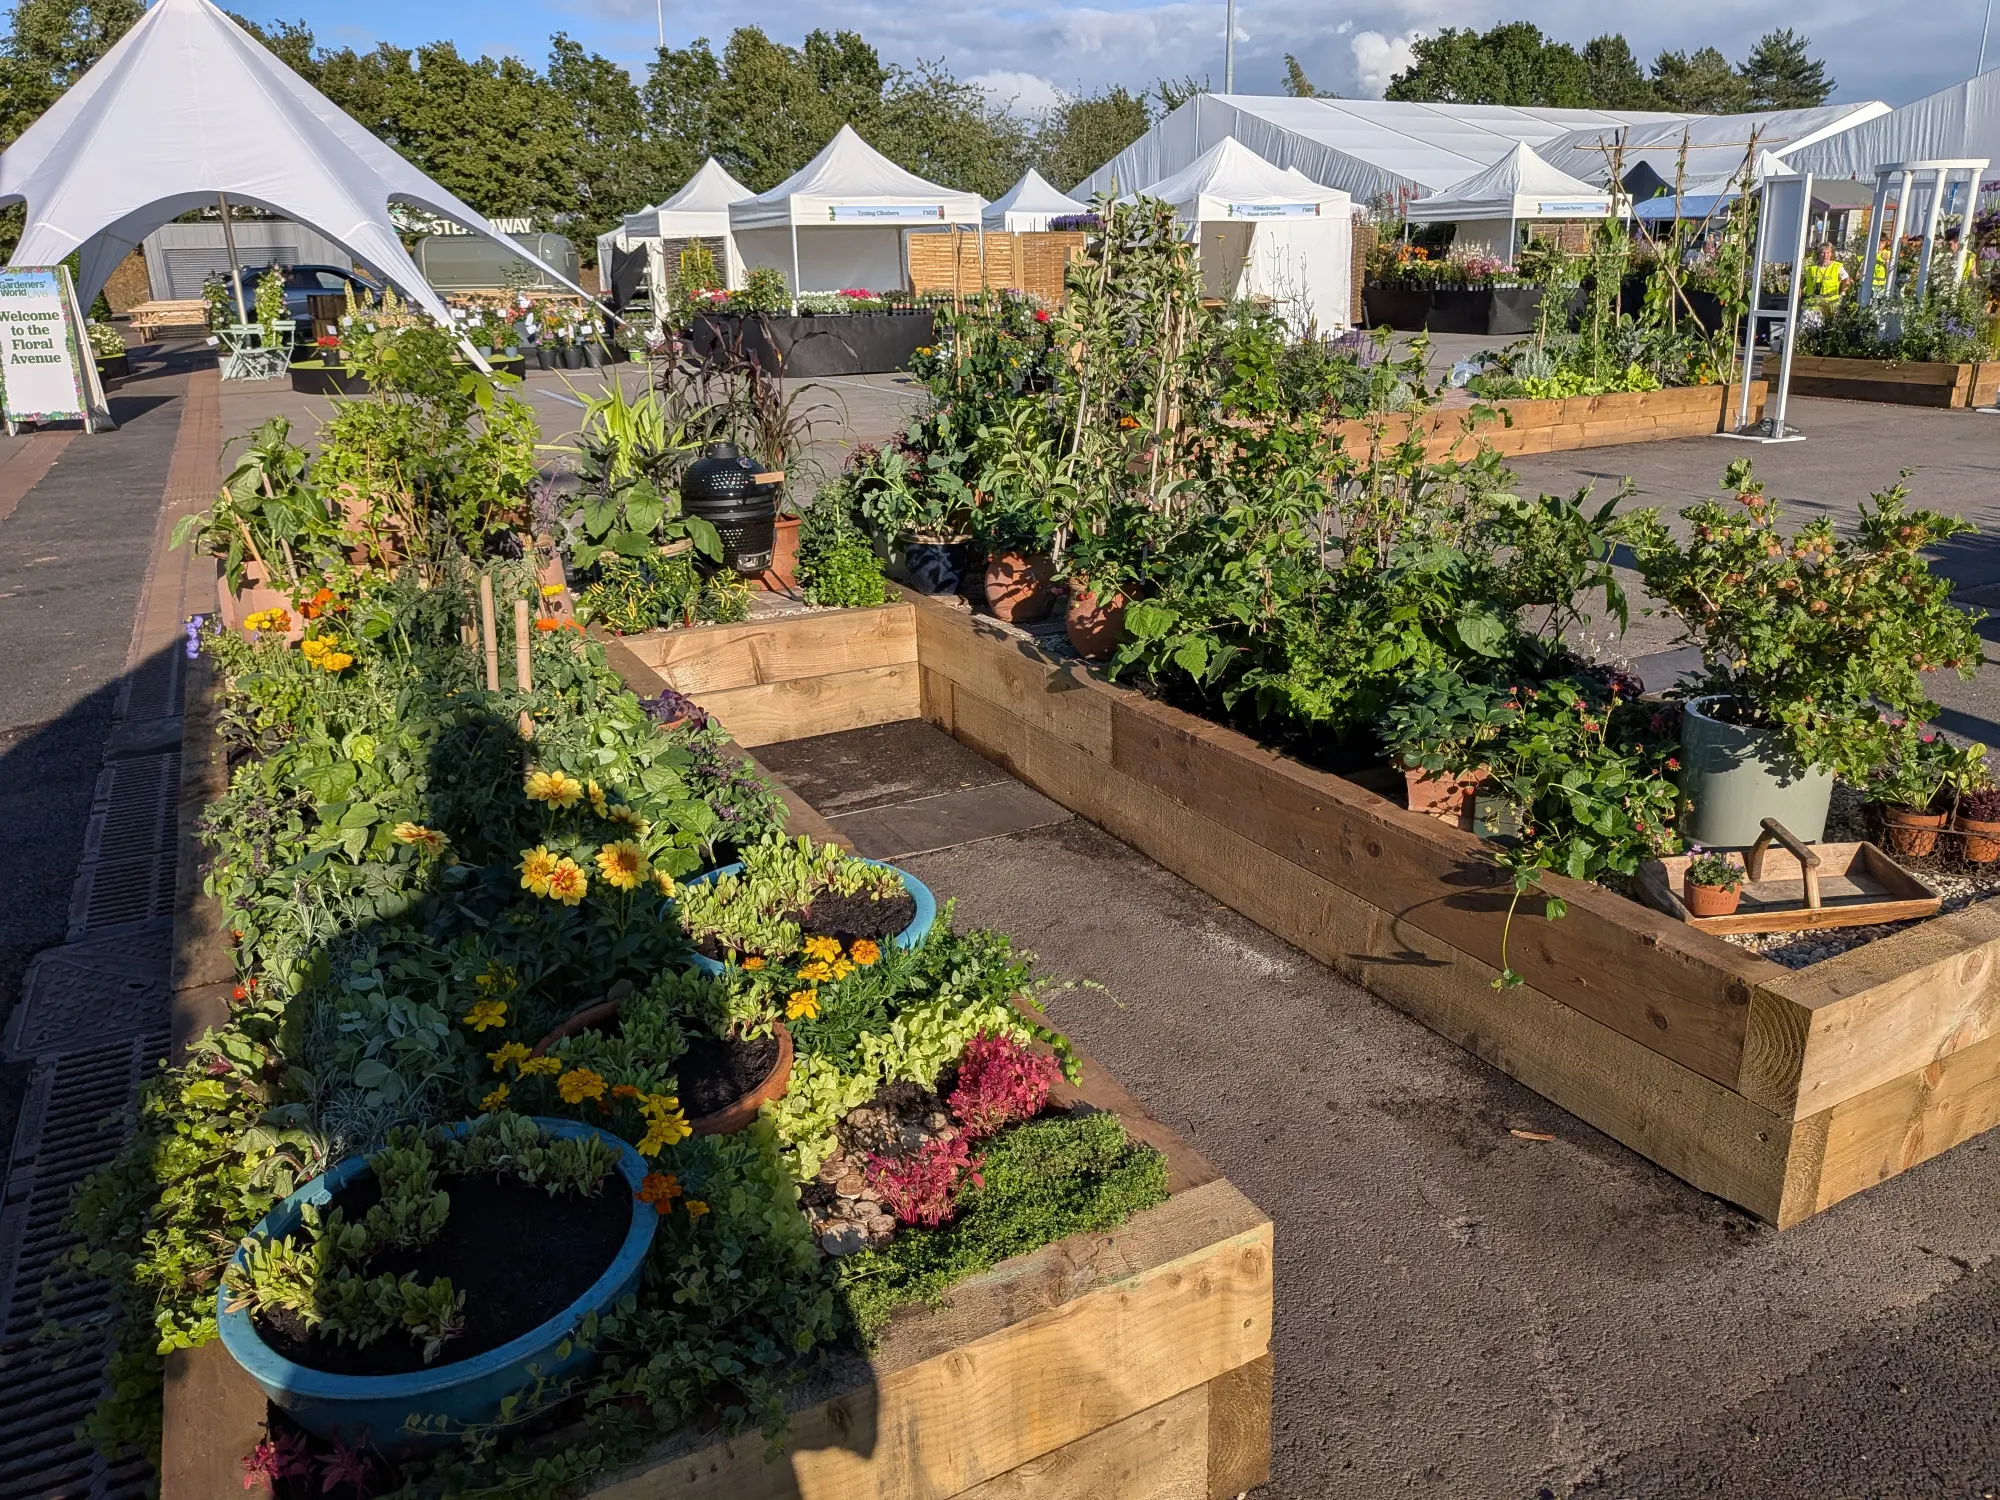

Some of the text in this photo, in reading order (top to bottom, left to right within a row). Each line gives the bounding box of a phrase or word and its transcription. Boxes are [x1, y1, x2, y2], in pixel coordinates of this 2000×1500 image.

[28, 290, 48, 298] Live
[0, 311, 59, 322] Welcome
[11, 324, 50, 336] to the
[12, 338, 54, 350] Floral
[11, 354, 61, 364] Avenue
